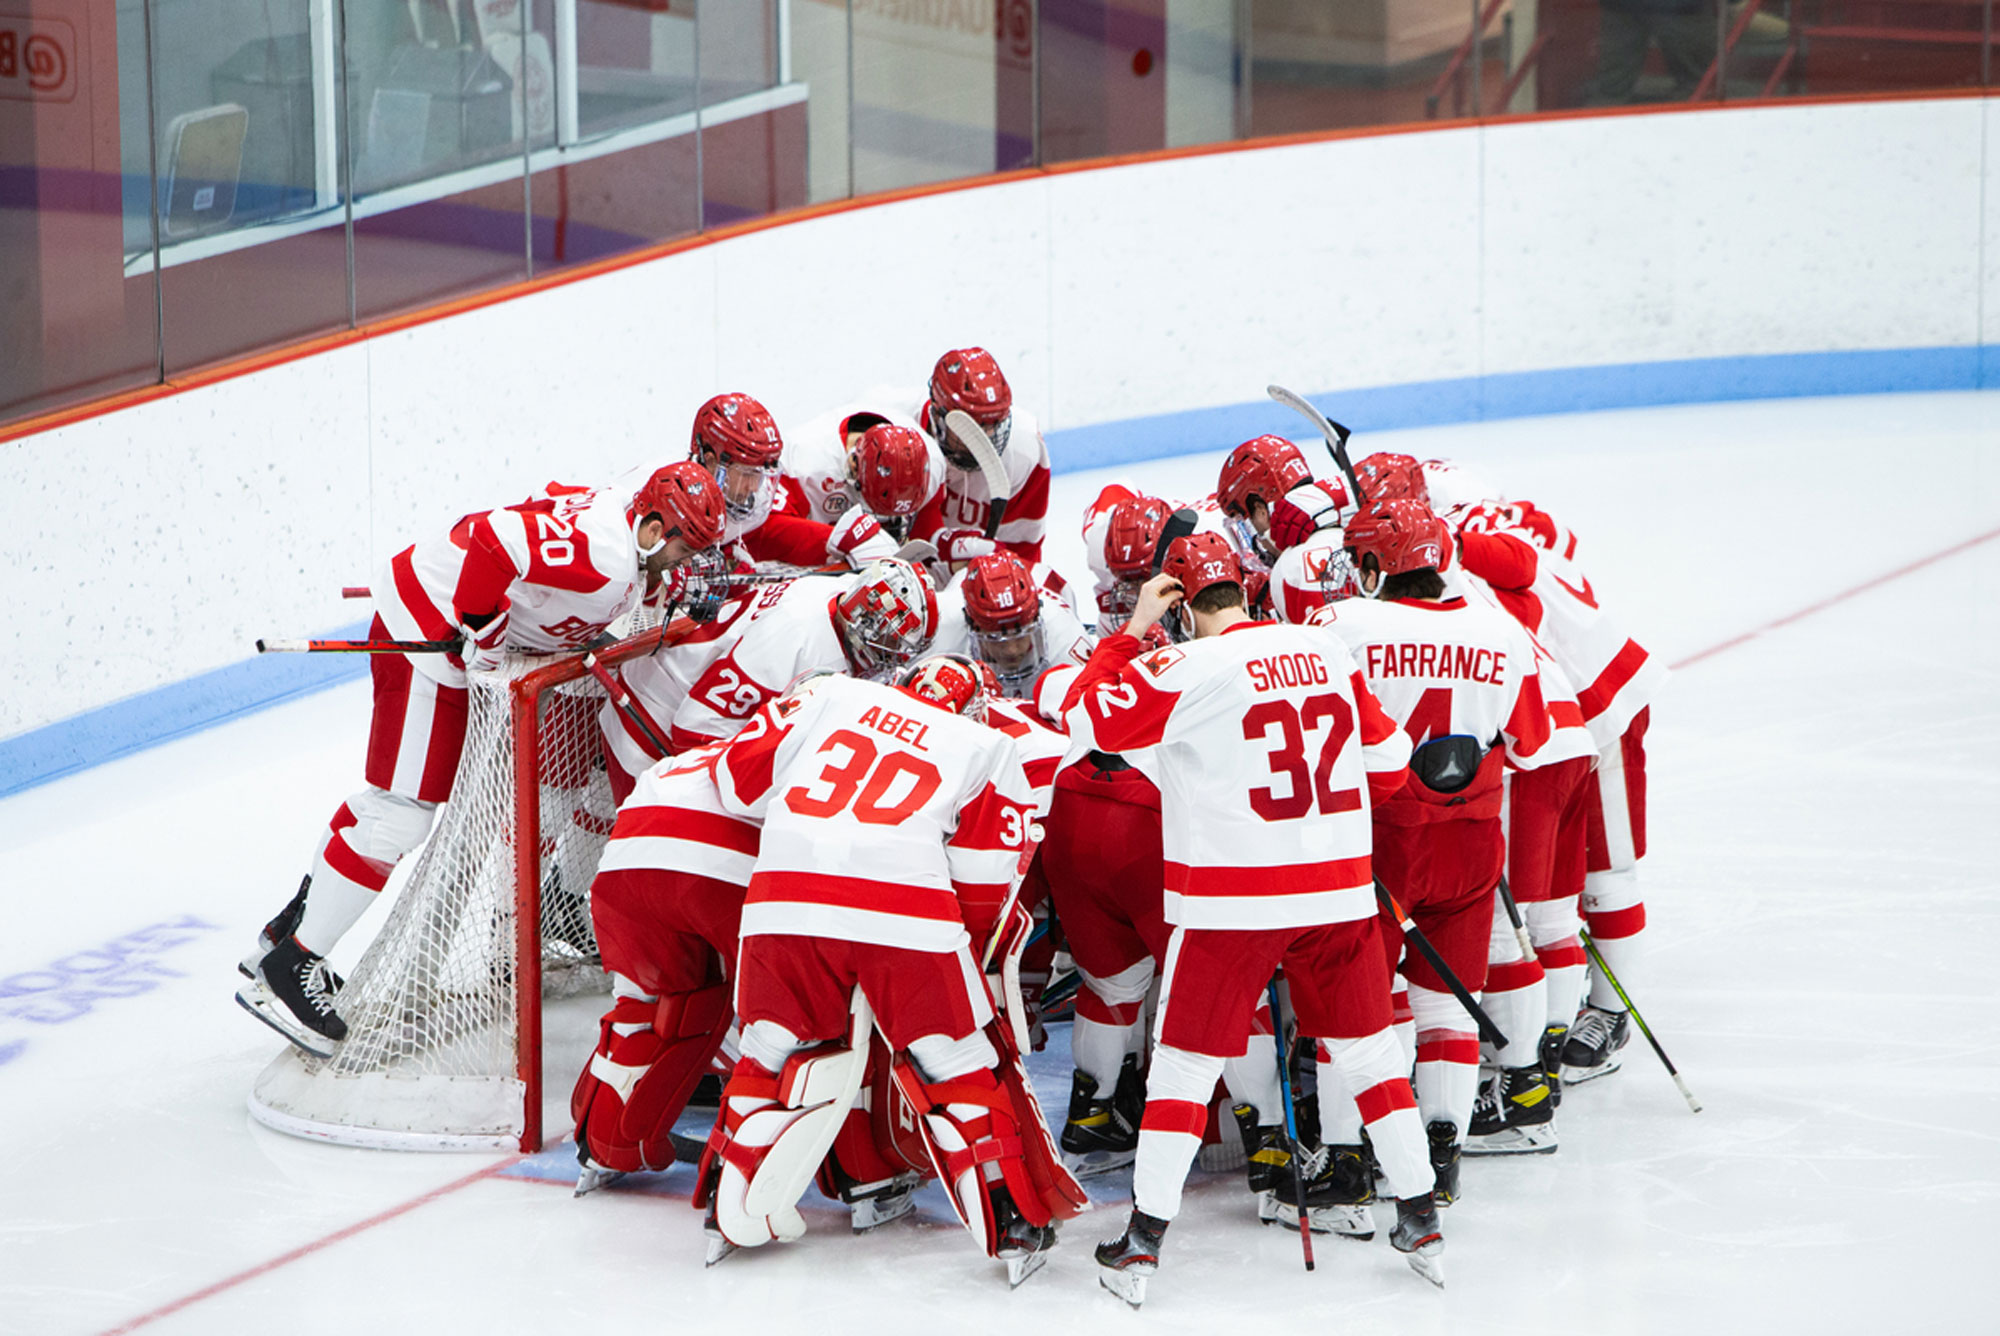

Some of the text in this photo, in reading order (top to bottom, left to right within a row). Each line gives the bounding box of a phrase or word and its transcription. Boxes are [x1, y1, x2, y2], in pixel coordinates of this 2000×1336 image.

[894, 501, 911, 512] 25
[540, 514, 575, 566] 20
[1123, 545, 1131, 560] 7
[1203, 561, 1225, 579] 32
[1245, 652, 1329, 693] SKOOG
[1366, 643, 1507, 686] FARRANCE
[705, 668, 761, 715] 29
[858, 705, 930, 752] ABEL
[1403, 687, 1454, 757] 4
[783, 728, 943, 827] 30
[1241, 692, 1363, 823] 32
